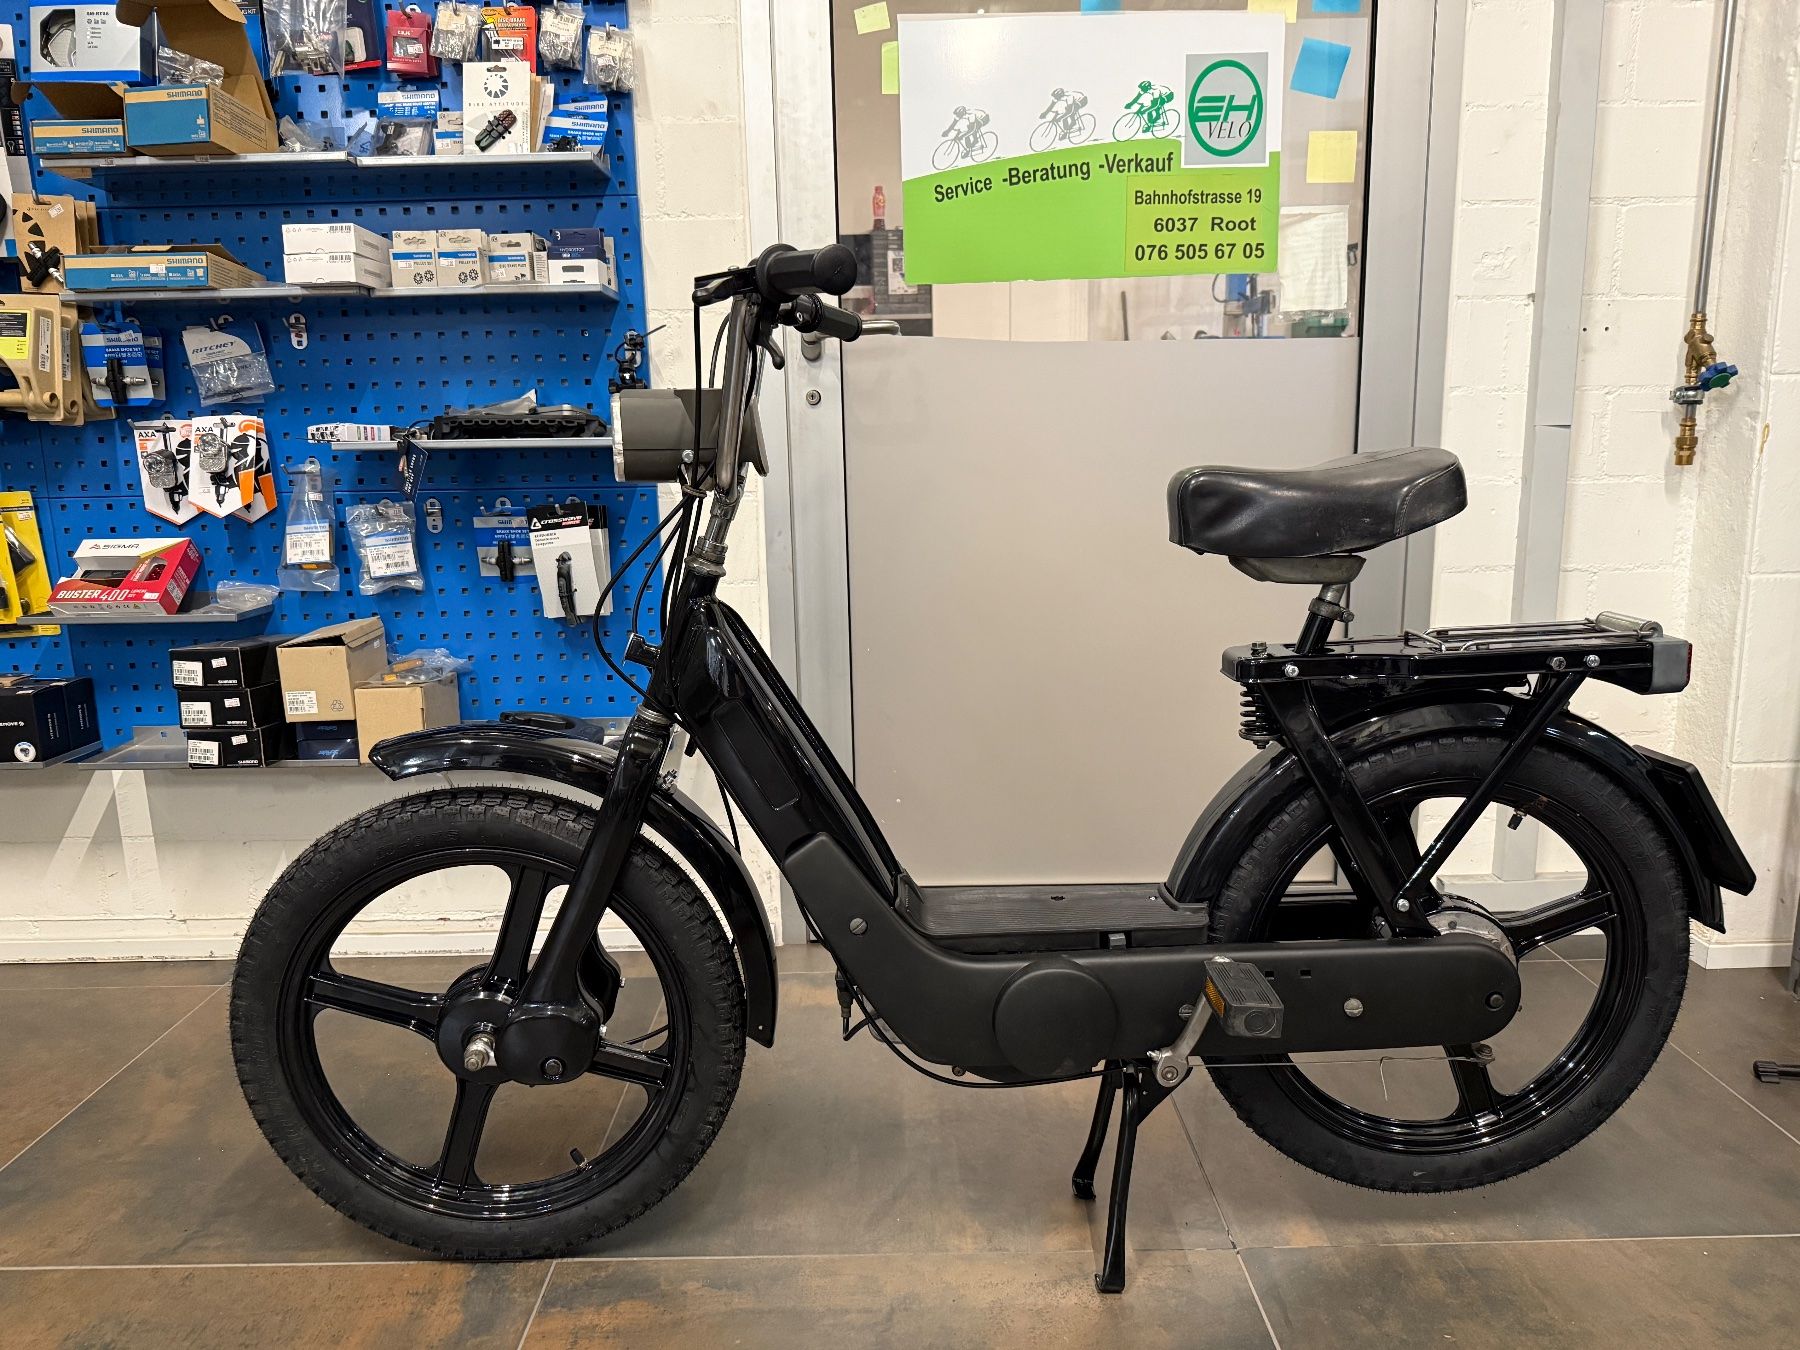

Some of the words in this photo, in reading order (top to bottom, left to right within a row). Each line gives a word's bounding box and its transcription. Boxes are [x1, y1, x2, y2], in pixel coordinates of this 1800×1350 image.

[166, 89, 203, 98] SHIMANO
[401, 92, 436, 100] SHIMANO
[573, 103, 605, 111] SHIMANO
[571, 121, 605, 129] SHIMANO
[1207, 120, 1252, 139] VELO
[934, 176, 993, 203] Service
[1002, 160, 1091, 187] -Beratung
[1098, 152, 1174, 174] -Verkauf
[1134, 189, 1242, 205] Bahnhofstrasse
[1246, 188, 1262, 203] 19
[1153, 217, 1199, 233] 6037
[1210, 216, 1257, 232] Root
[1134, 244, 1169, 261] 076
[1174, 243, 1208, 260] 505
[1214, 243, 1237, 259] 67
[1242, 242, 1265, 259] 05
[166, 257, 204, 265] SHIMANO
[192, 341, 235, 355] RITCHEY
[55, 589, 100, 599] BUSTER
[98, 589, 129, 601] 400
